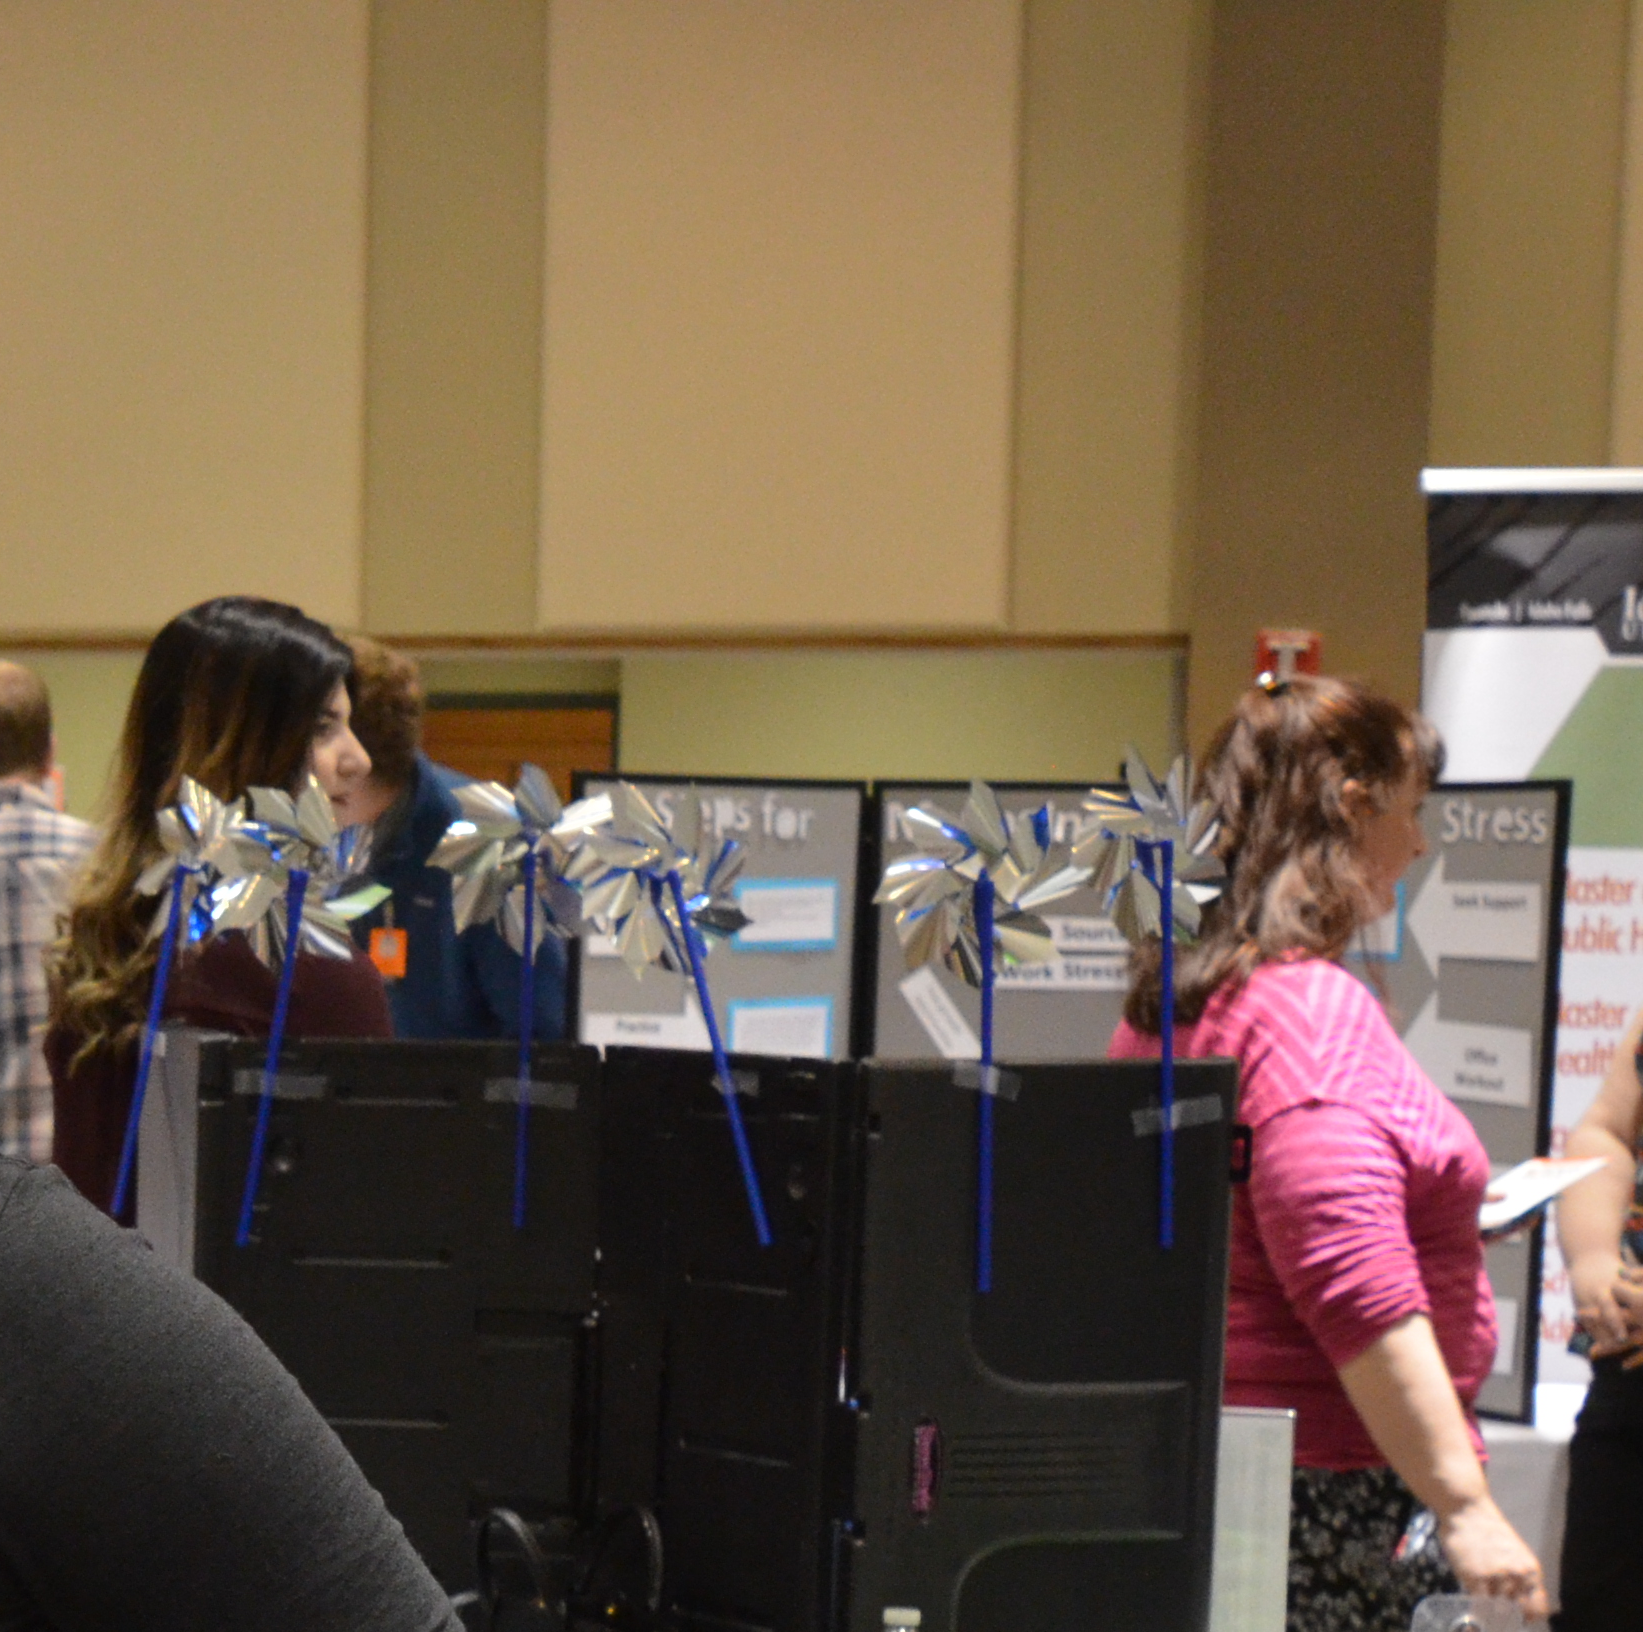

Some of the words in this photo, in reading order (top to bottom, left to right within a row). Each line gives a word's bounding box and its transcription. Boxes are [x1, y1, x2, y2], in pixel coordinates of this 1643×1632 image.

[1441, 800, 1548, 844] Stress
[1566, 874, 1635, 901] aster
[1563, 917, 1623, 952] ublic
[1559, 1000, 1627, 1028] aster
